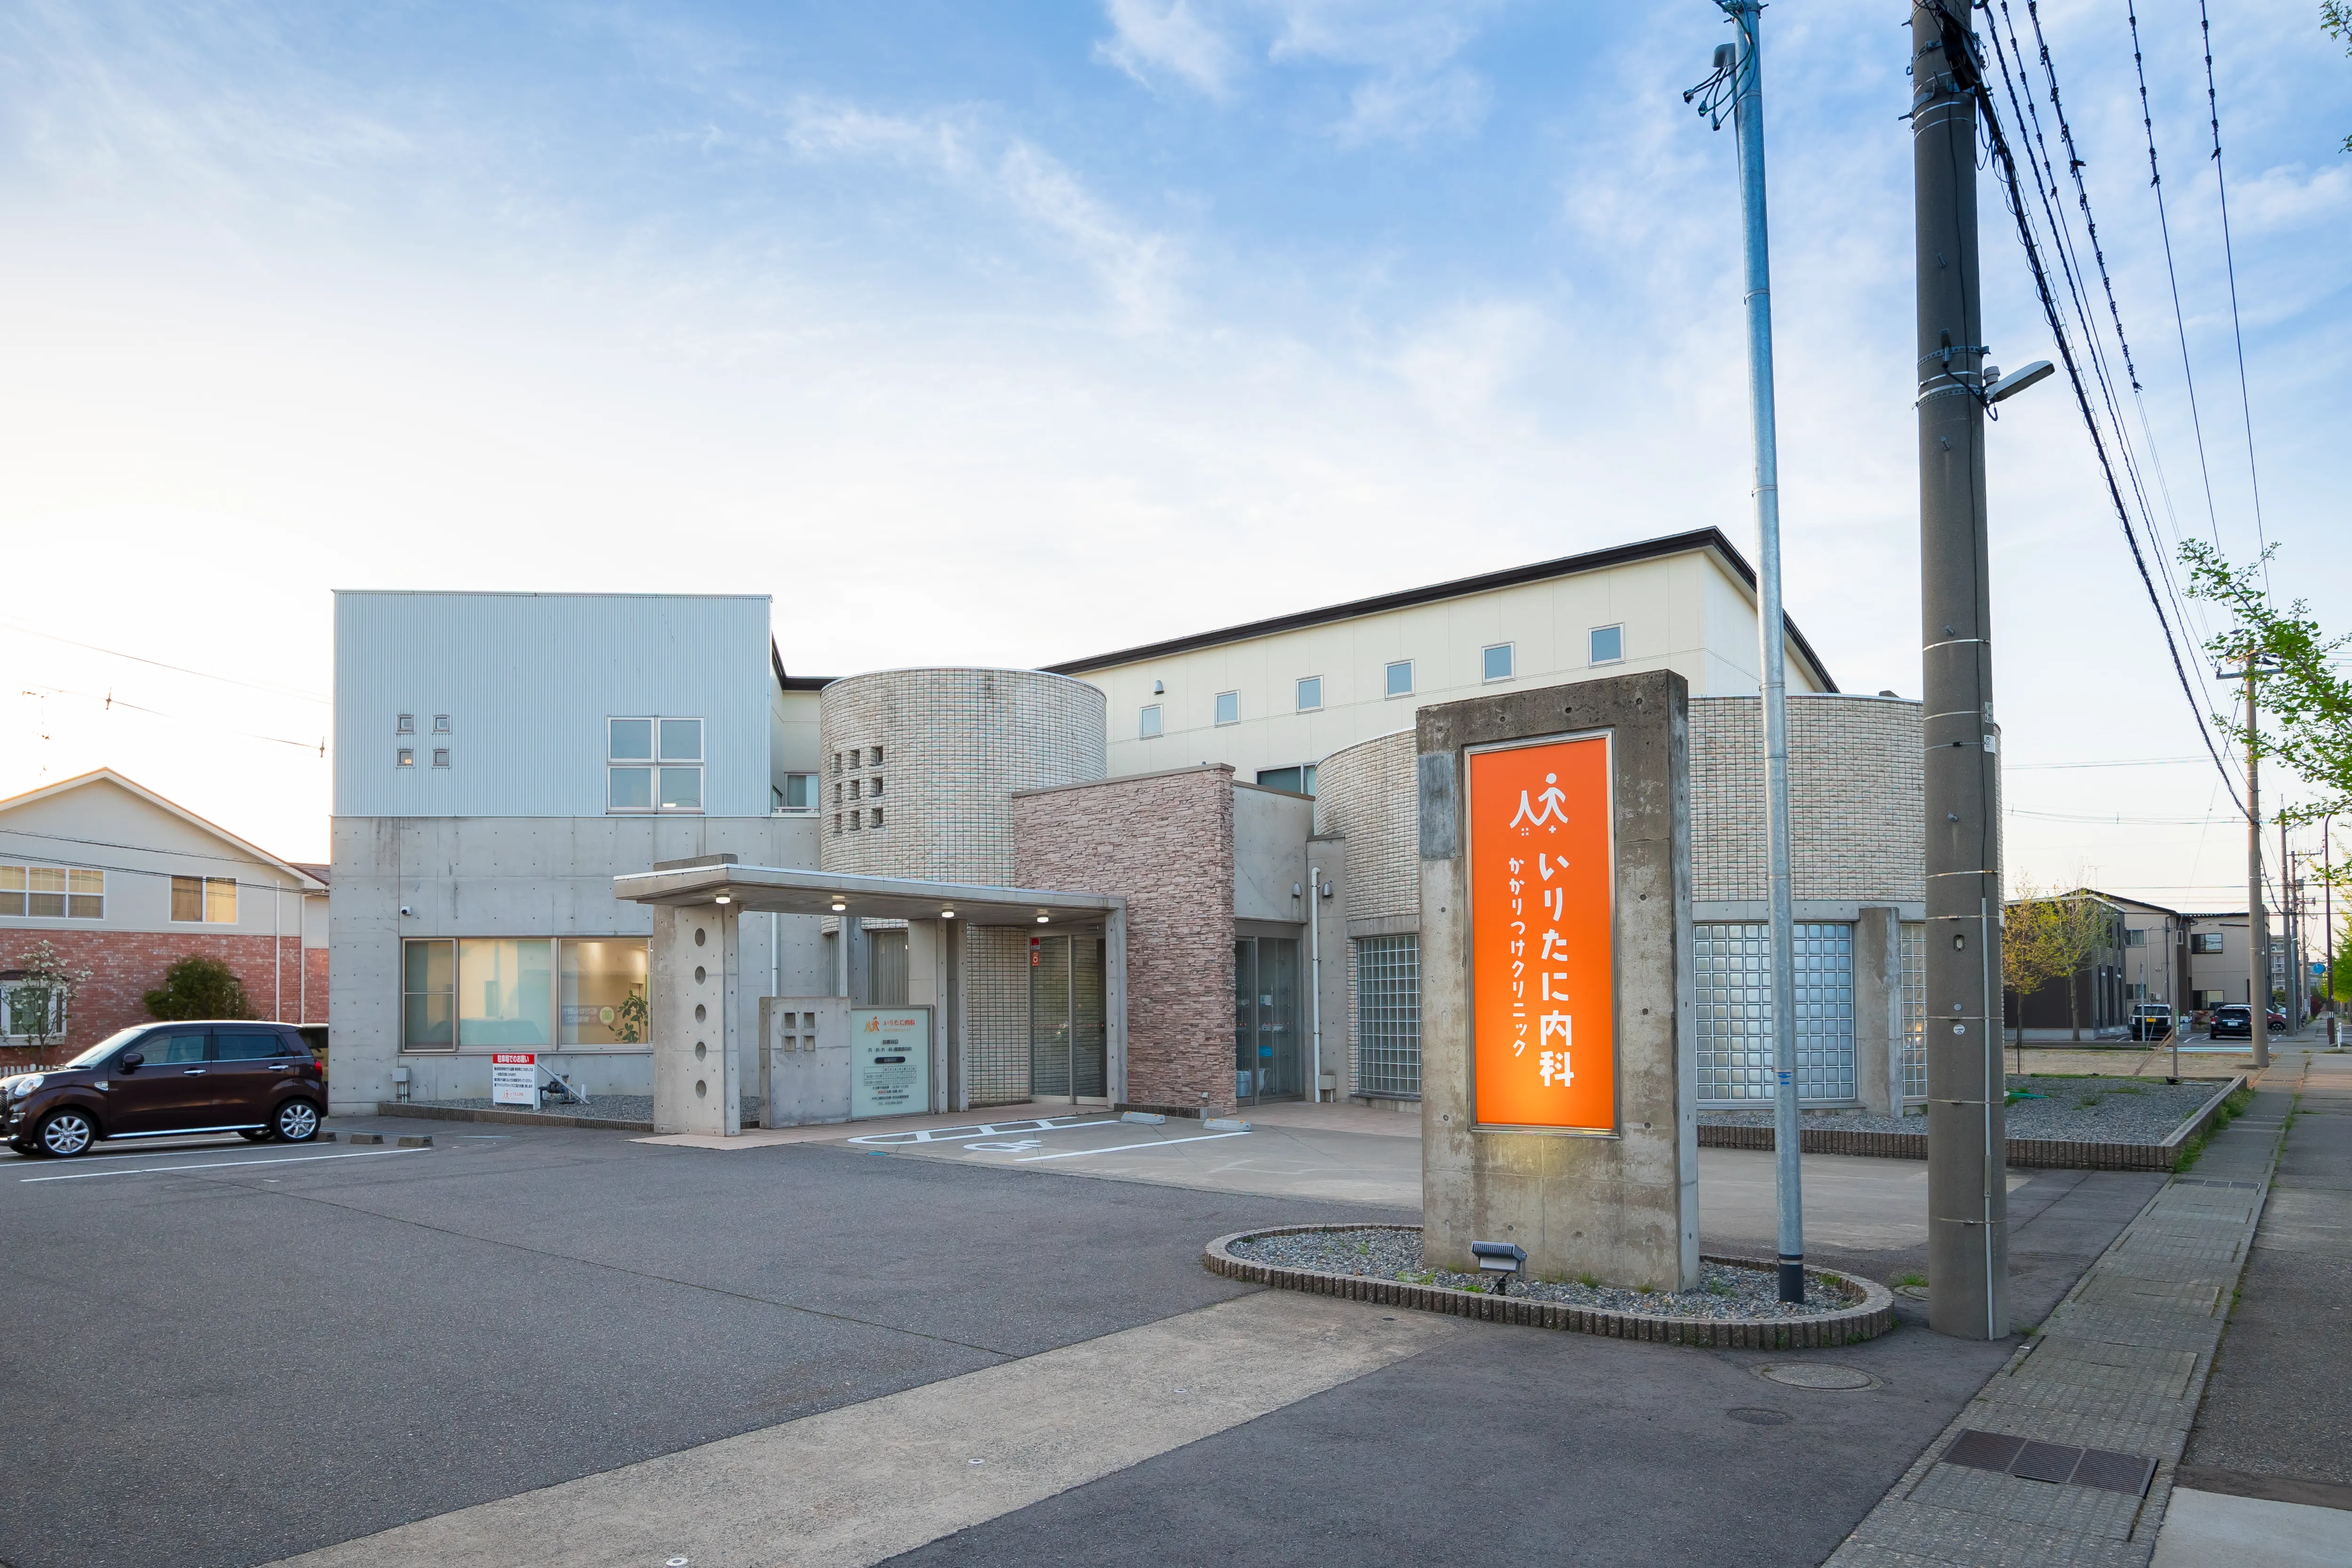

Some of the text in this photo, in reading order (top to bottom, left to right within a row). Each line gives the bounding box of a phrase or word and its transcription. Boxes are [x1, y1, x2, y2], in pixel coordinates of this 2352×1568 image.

[1509, 858, 1527, 1057] かかりつけクリニック
[1539, 853, 1574, 1087] いりたに内科
